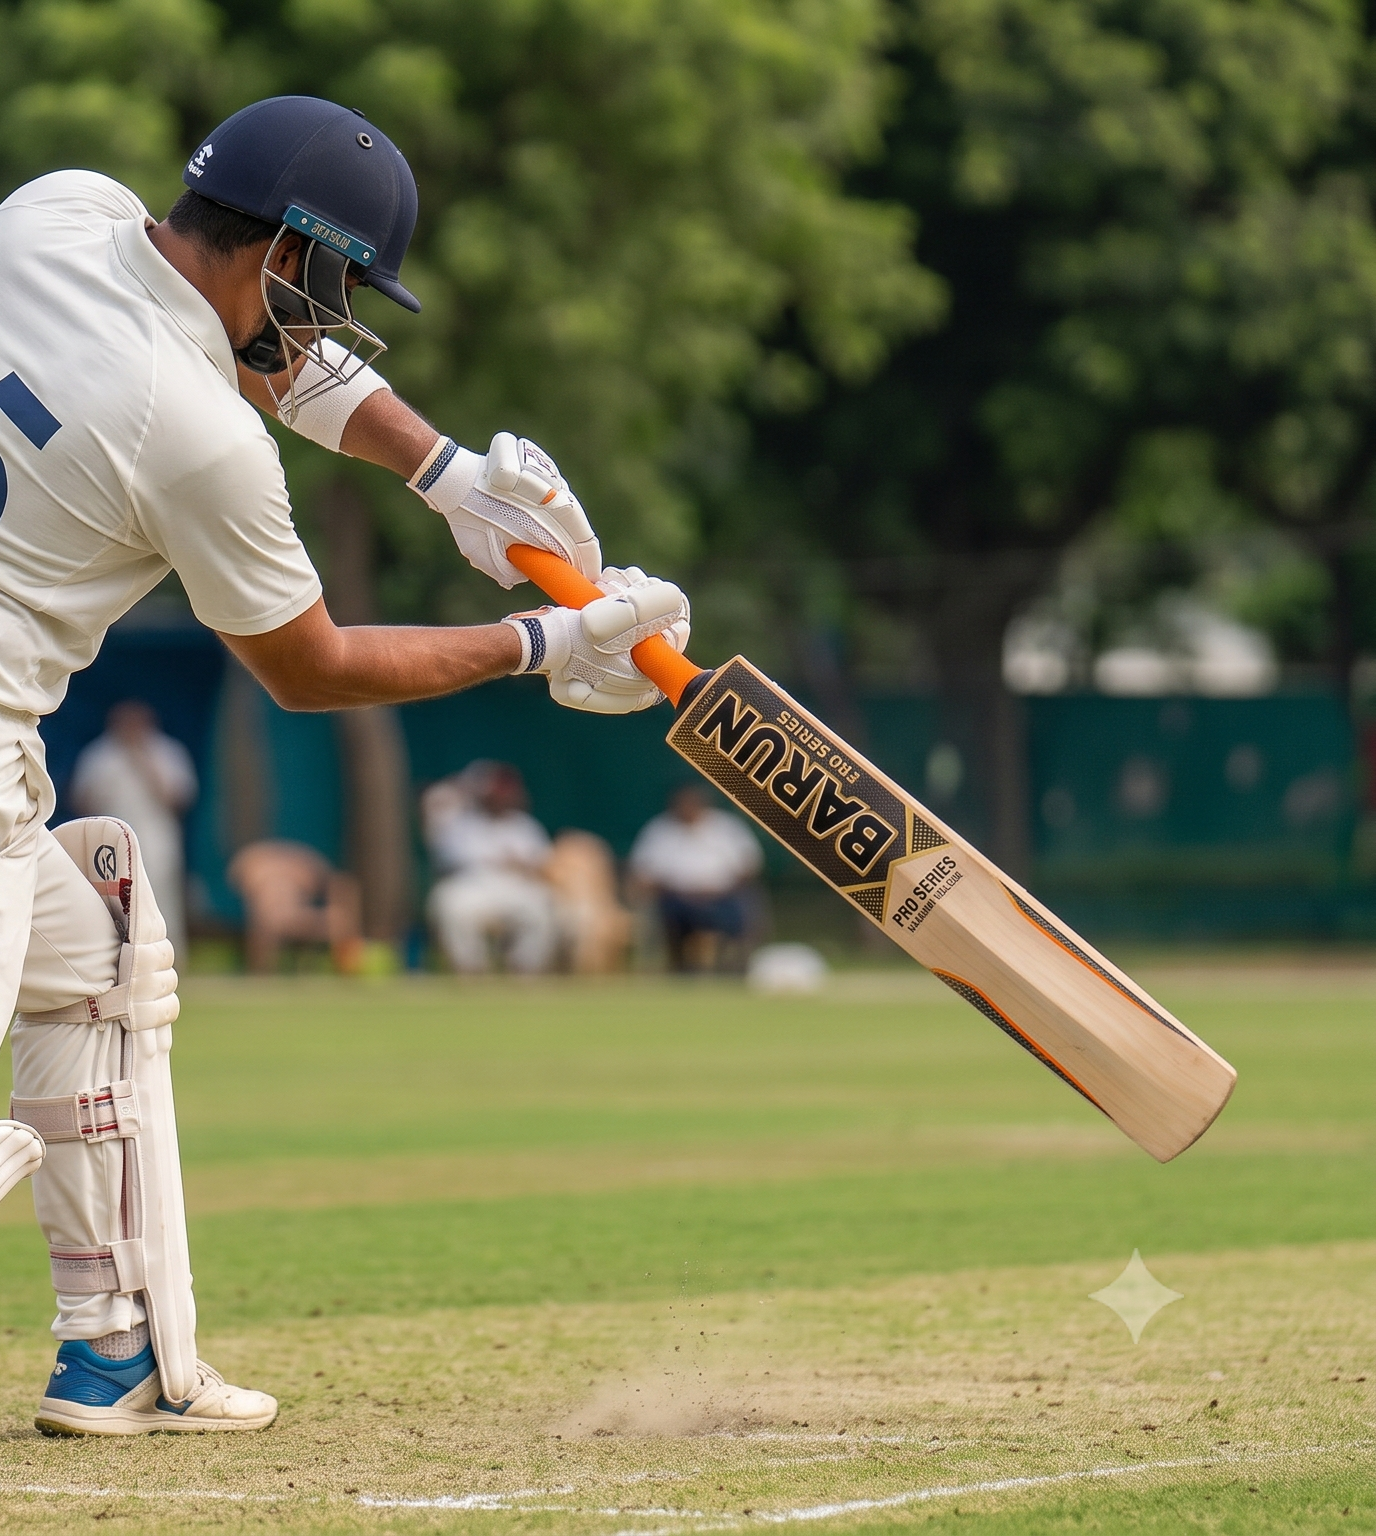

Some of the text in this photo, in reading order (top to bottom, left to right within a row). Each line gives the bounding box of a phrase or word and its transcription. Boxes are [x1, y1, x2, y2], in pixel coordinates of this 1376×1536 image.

[775, 710, 831, 758] SERIES
[693, 688, 899, 877] BARUN
[891, 894, 920, 928] PRO
[912, 855, 957, 903] SERIES
